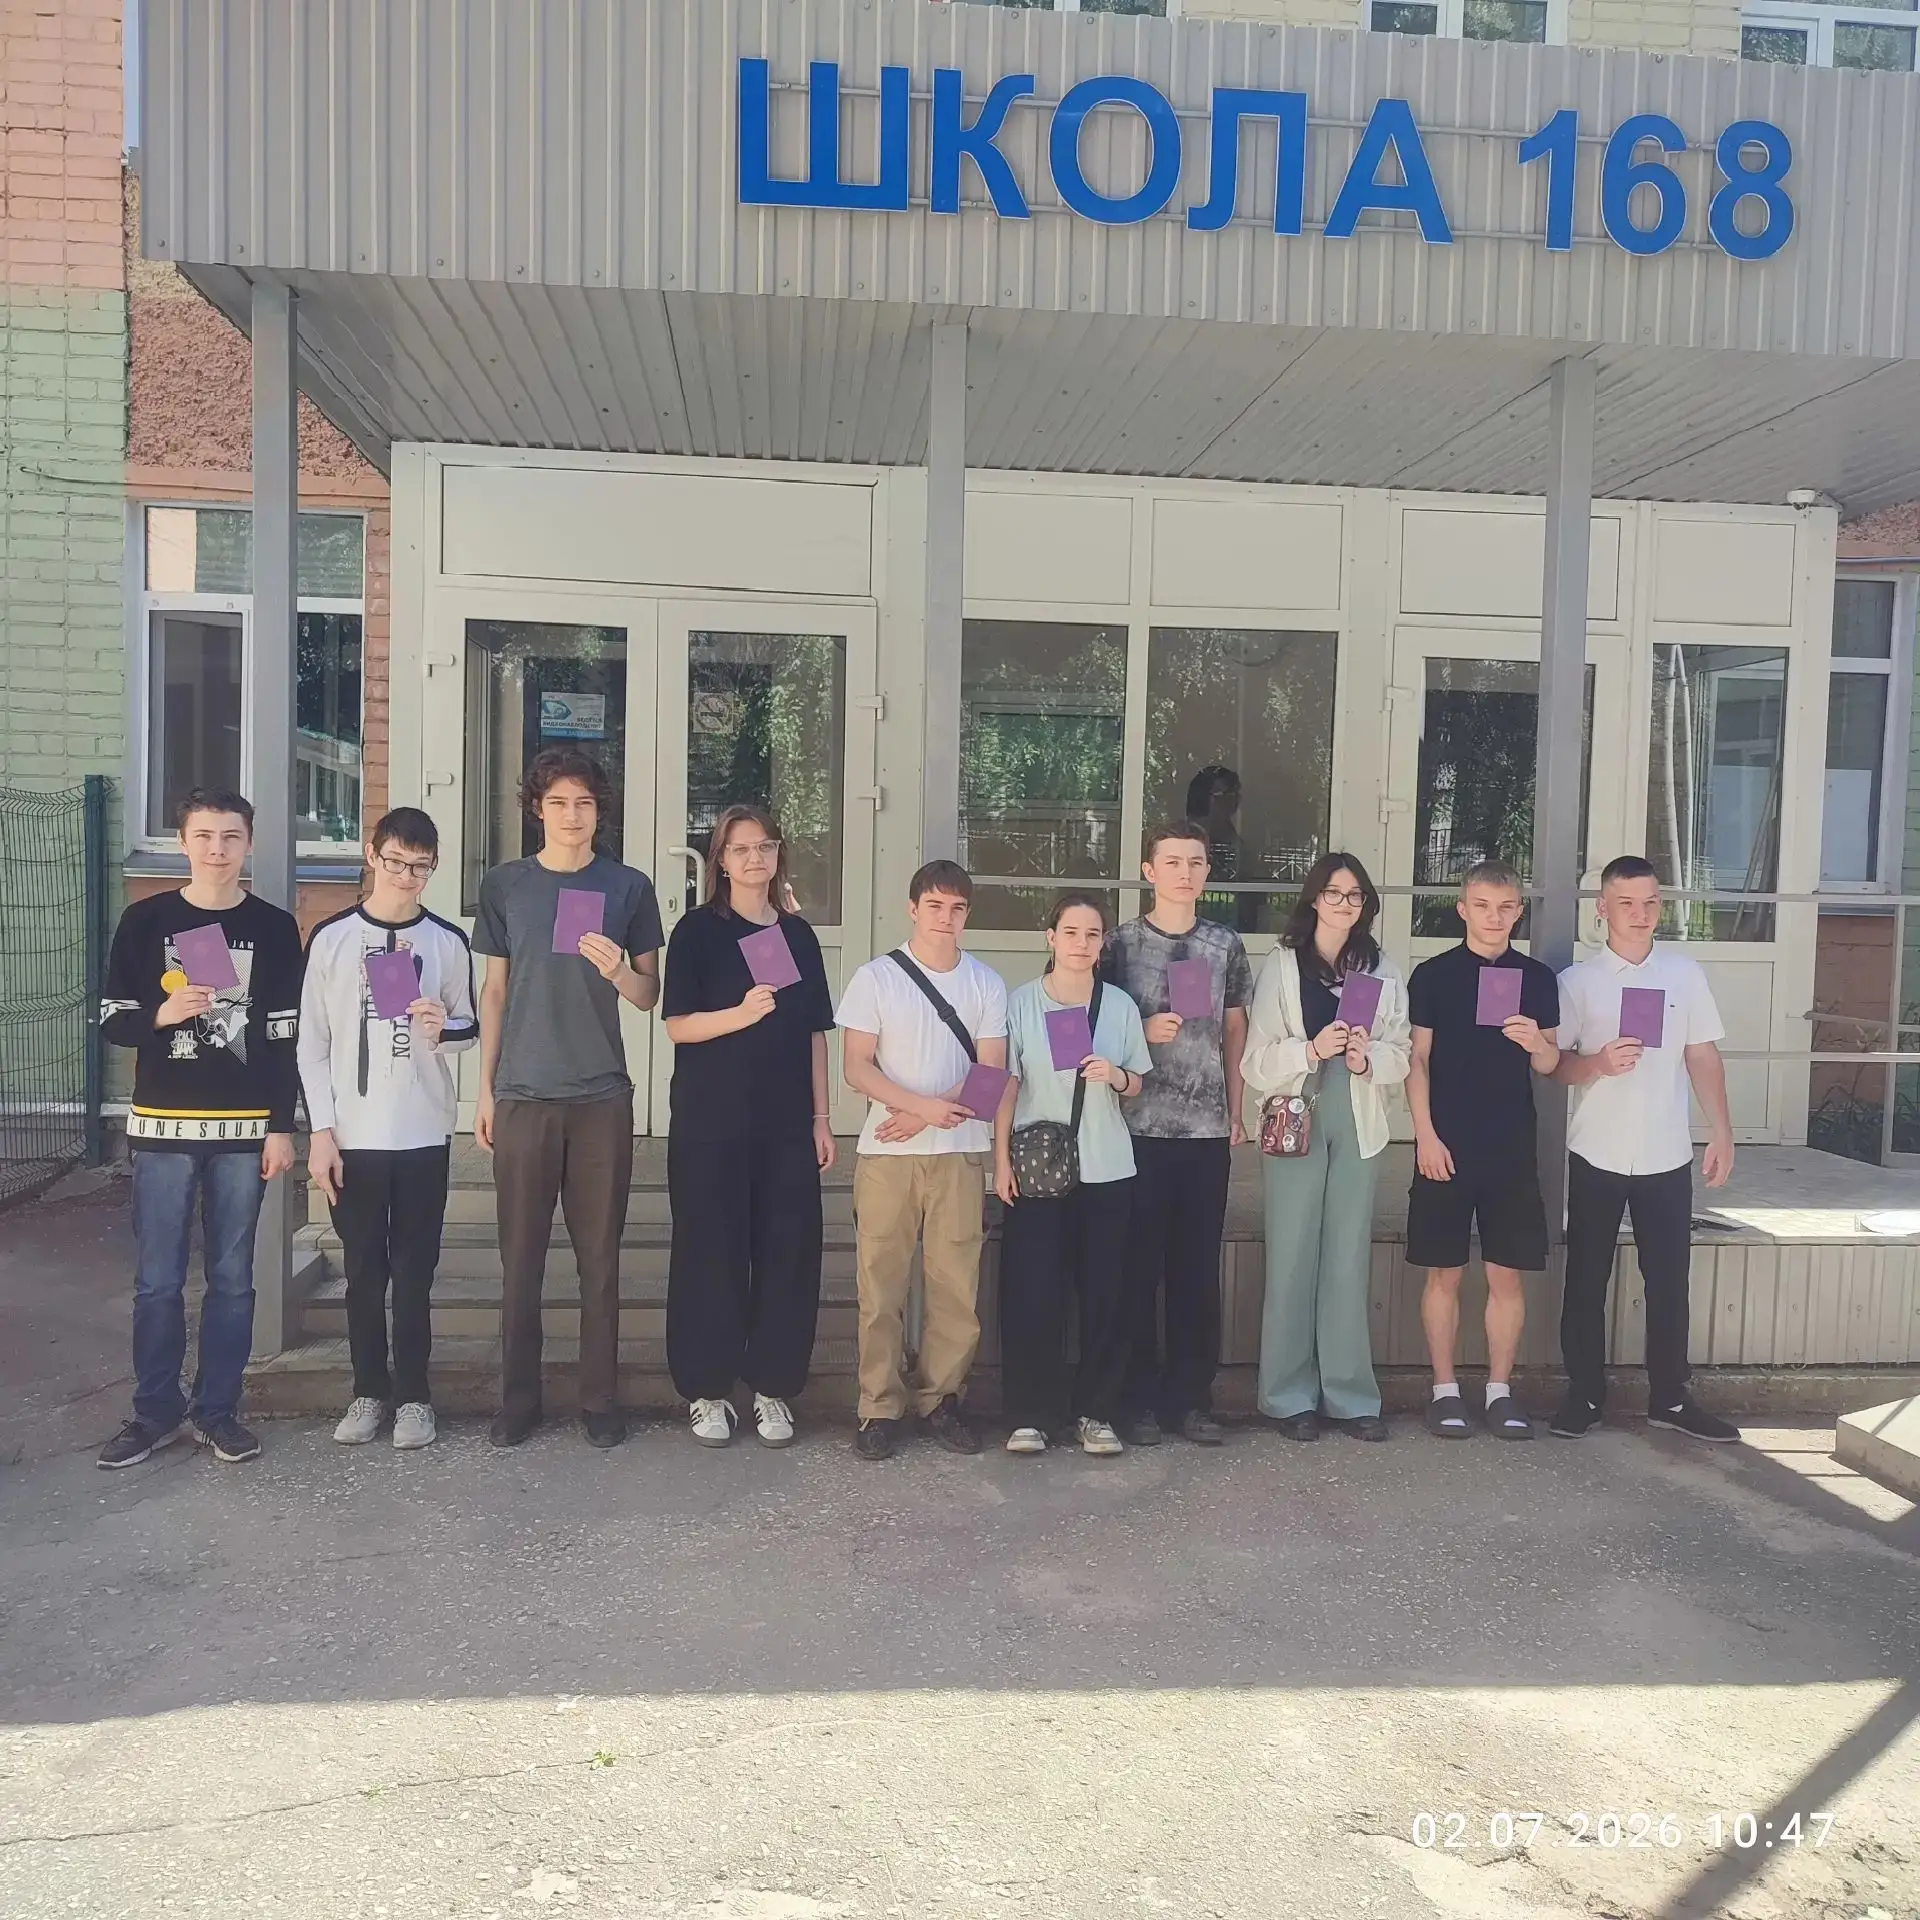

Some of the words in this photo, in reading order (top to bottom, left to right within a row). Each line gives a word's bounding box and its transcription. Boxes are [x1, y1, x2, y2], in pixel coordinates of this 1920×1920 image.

[739, 57, 1454, 245] ШКОЛА
[1518, 109, 1796, 260] 168
[232, 940, 254, 949] JAM
[174, 1030, 194, 1041] SPACE
[172, 1042, 195, 1055] JAM
